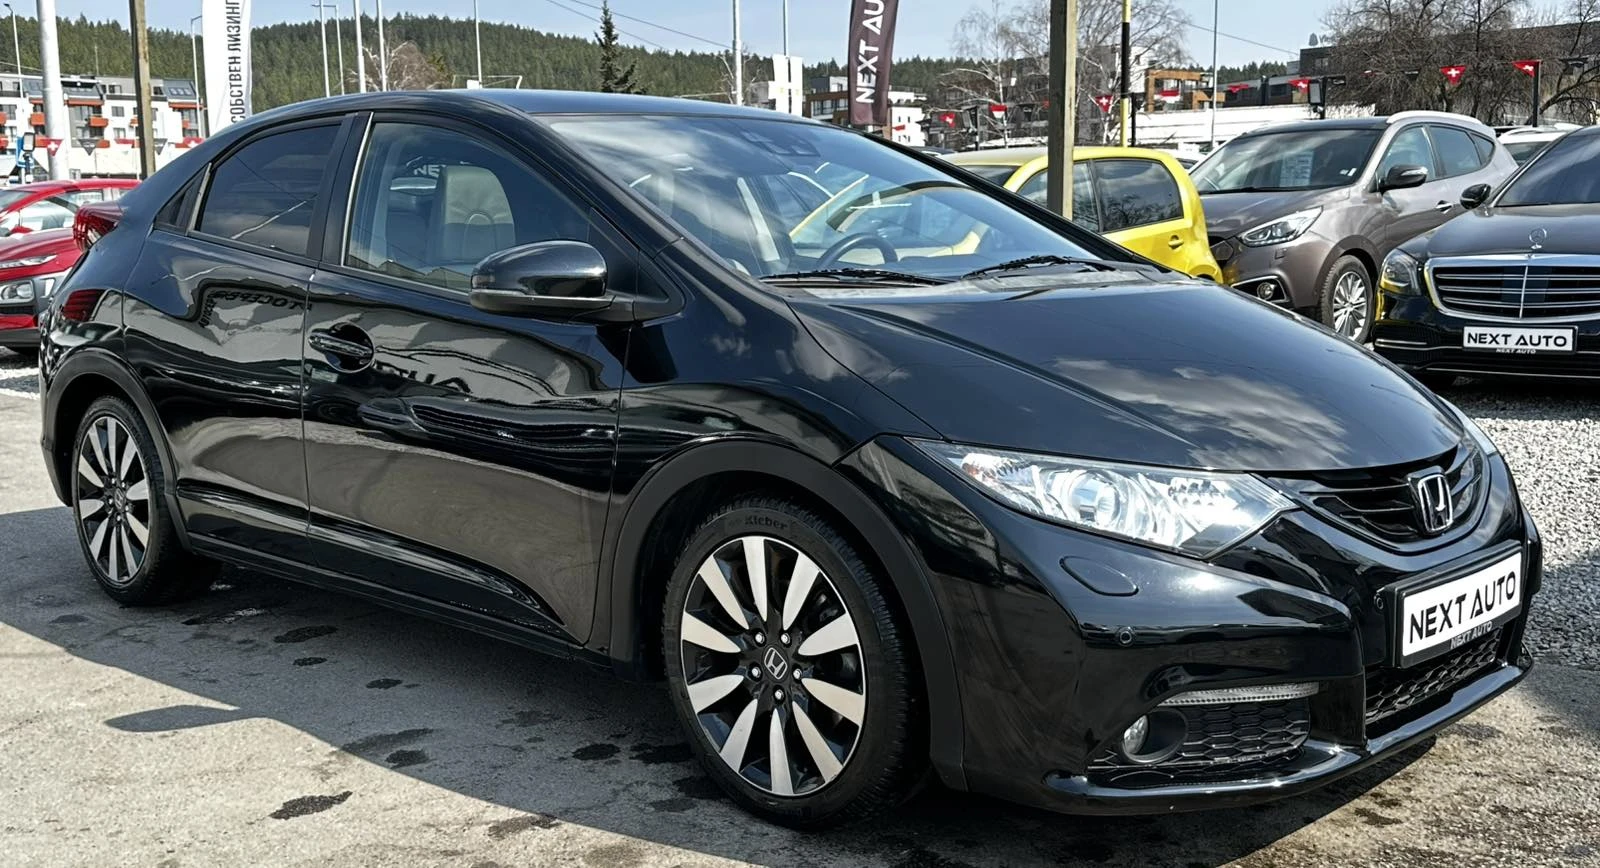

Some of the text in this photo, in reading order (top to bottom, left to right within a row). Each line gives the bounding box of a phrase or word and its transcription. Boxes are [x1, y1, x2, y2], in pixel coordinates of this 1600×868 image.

[225, 0, 246, 123] СОБСТВЕН ЛИЗИНГ
[856, 39, 879, 103] NEXT
[1467, 332, 1567, 347] NEXT AUTO
[744, 515, 788, 530] Kleber
[1409, 571, 1516, 644] NEXT AUTO
[1450, 621, 1493, 650] NEXT AUTO
